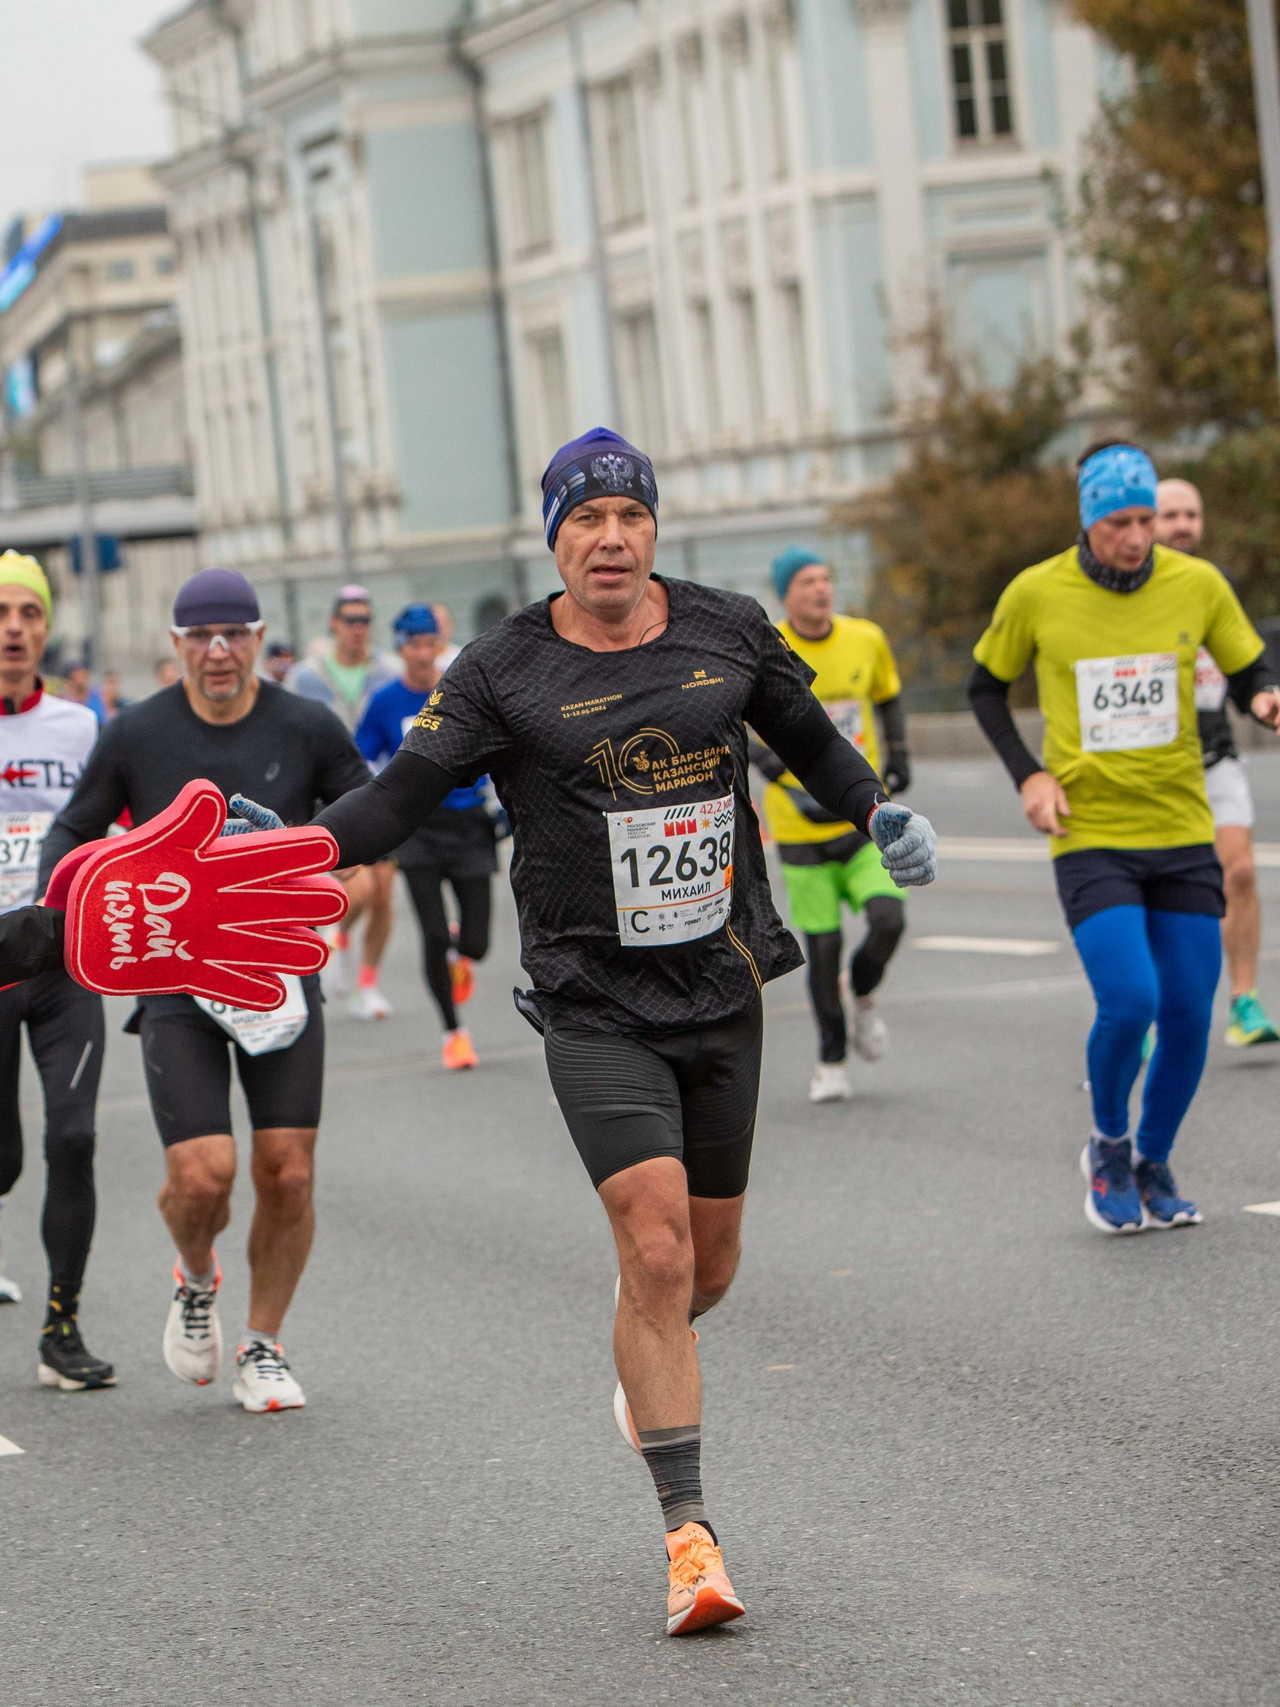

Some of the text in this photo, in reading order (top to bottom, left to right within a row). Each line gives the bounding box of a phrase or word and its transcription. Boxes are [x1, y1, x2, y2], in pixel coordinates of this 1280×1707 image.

[682, 677, 724, 689] NORDSKI
[1094, 678, 1164, 710] 6348
[561, 693, 622, 712] KAZAN MARATHON
[652, 745, 731, 770] АК БАРС БАНК
[653, 755, 720, 782] КАЗАНСКИЙ
[655, 771, 714, 793] МАРАФОН
[699, 801, 722, 815] 42,2
[621, 831, 731, 888] 12638
[661, 882, 711, 901] МИХАИЛ
[102, 880, 138, 970] пять
[136, 871, 194, 961] Дай
[630, 910, 650, 933] C
